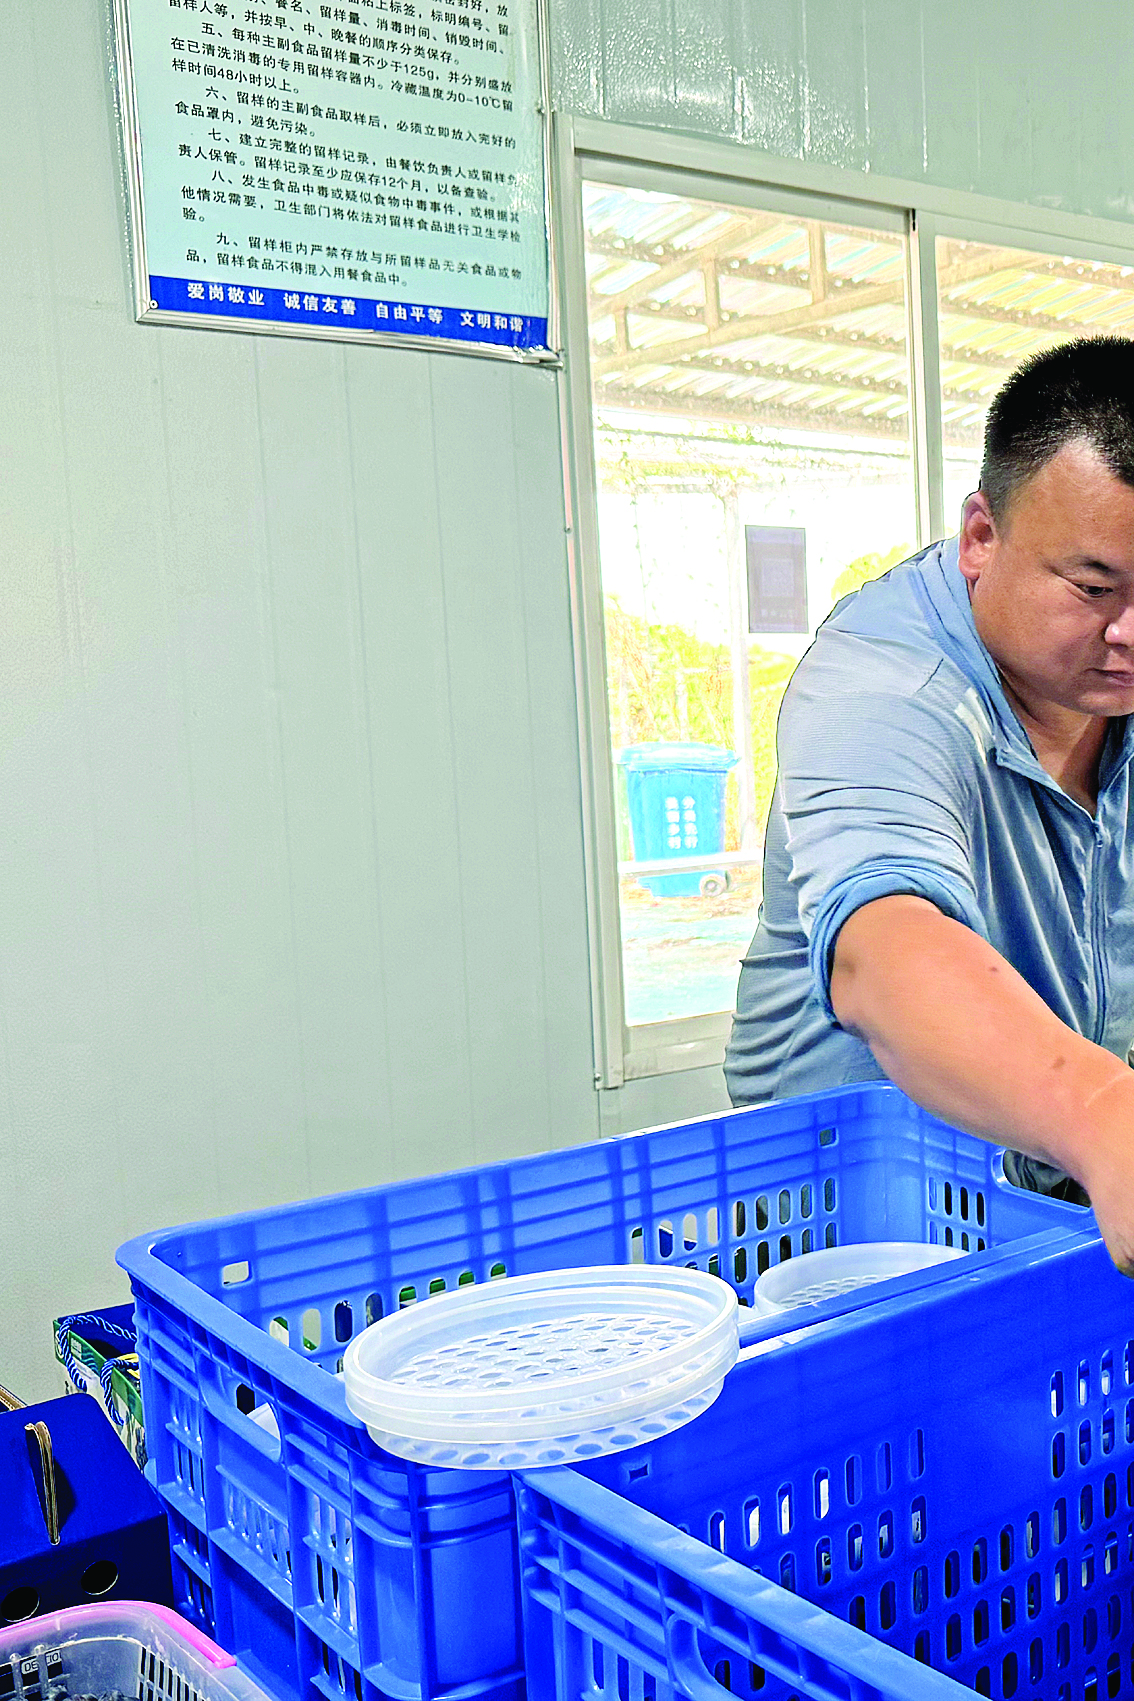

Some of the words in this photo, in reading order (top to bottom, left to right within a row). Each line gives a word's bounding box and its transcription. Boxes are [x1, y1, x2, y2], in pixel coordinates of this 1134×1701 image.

[171, 57, 300, 95] 样时间48小时以上。
[174, 100, 316, 138] 食品罩内，避免污染。
[182, 206, 206, 223] 验。
[186, 248, 408, 287] 品，留样食品不得混入用餐食品中。
[187, 281, 266, 307] 爱岗敬业
[282, 292, 357, 316] 诚信友善
[375, 302, 444, 325] 自由平等
[460, 310, 524, 334] 文明和谐
